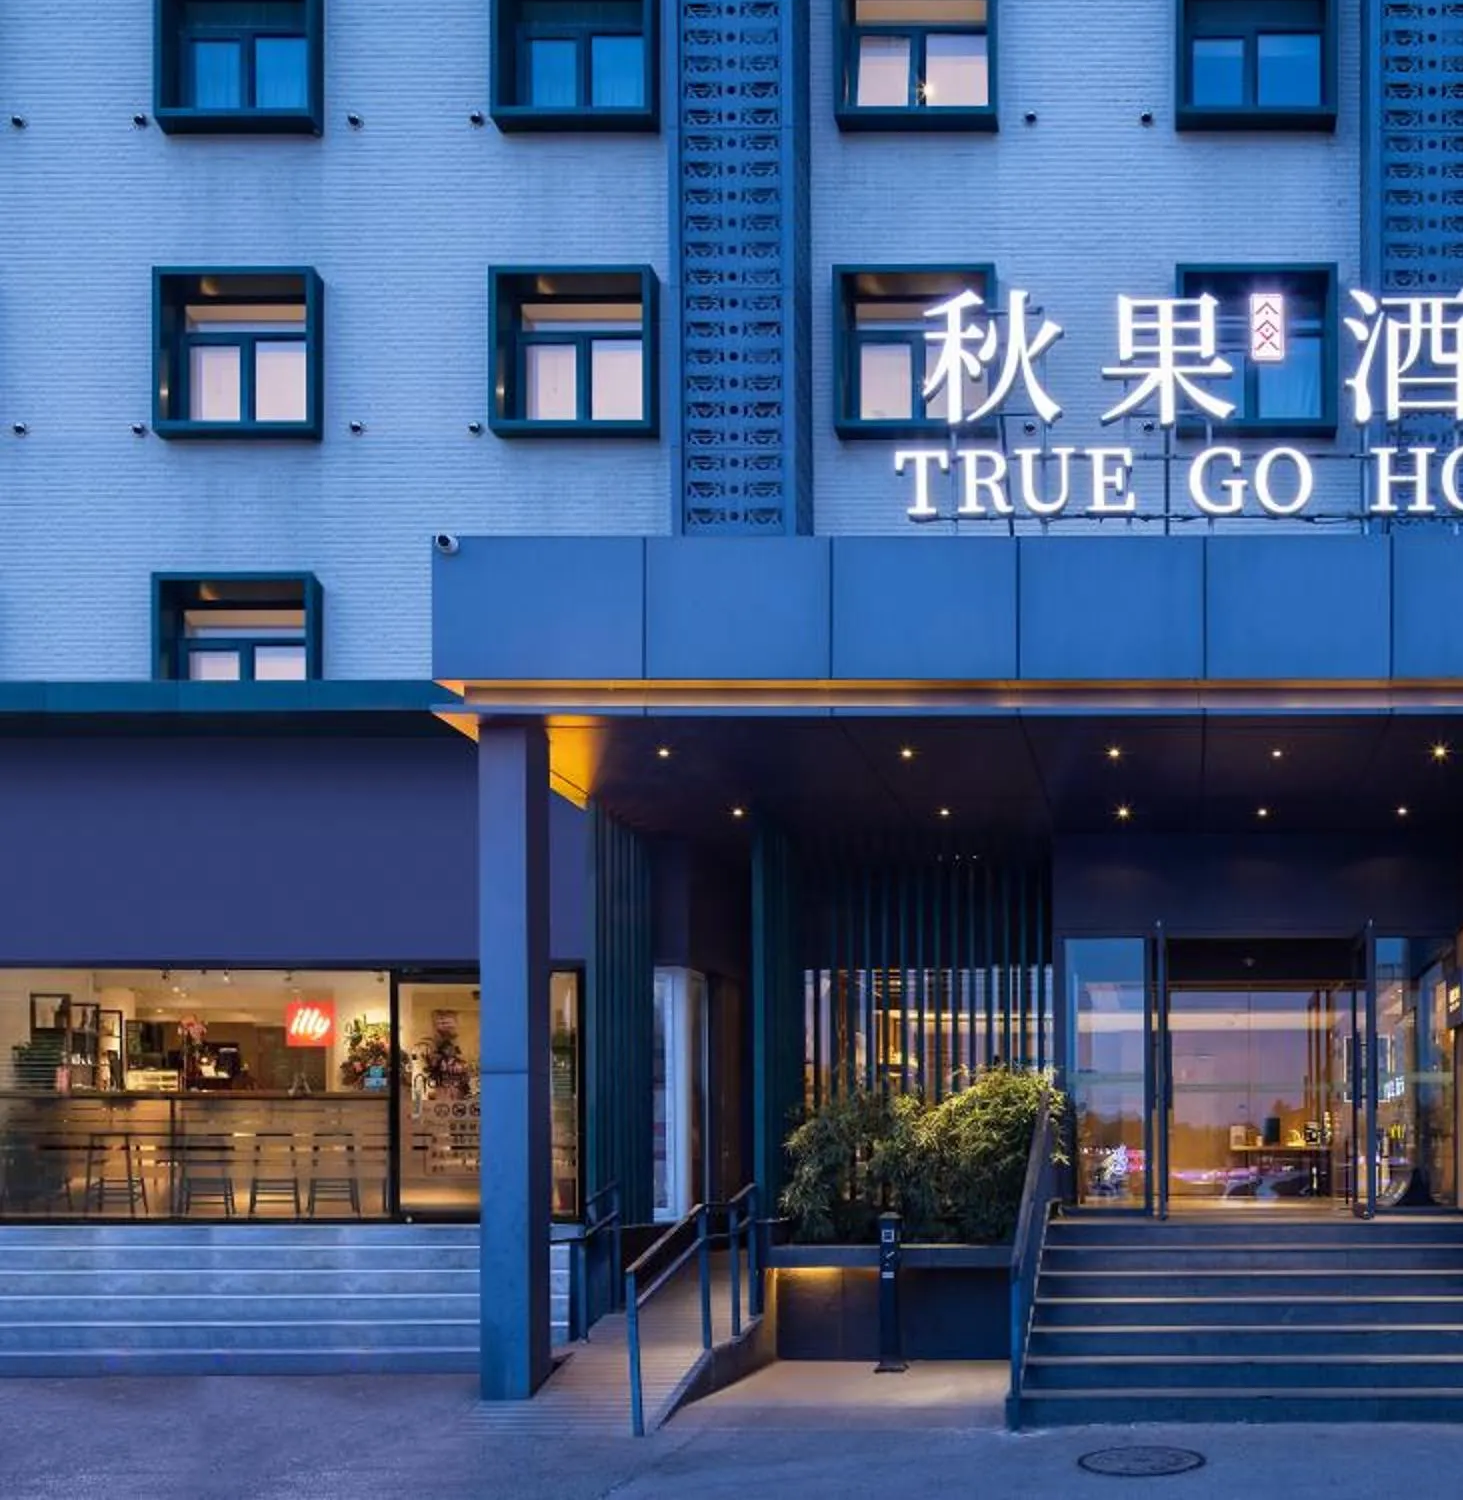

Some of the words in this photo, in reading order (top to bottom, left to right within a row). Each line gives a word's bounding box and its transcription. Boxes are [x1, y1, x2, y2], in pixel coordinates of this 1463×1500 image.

[894, 446, 1136, 516] TRUE
[1189, 445, 1315, 515] GO
[291, 1008, 330, 1041] illy
